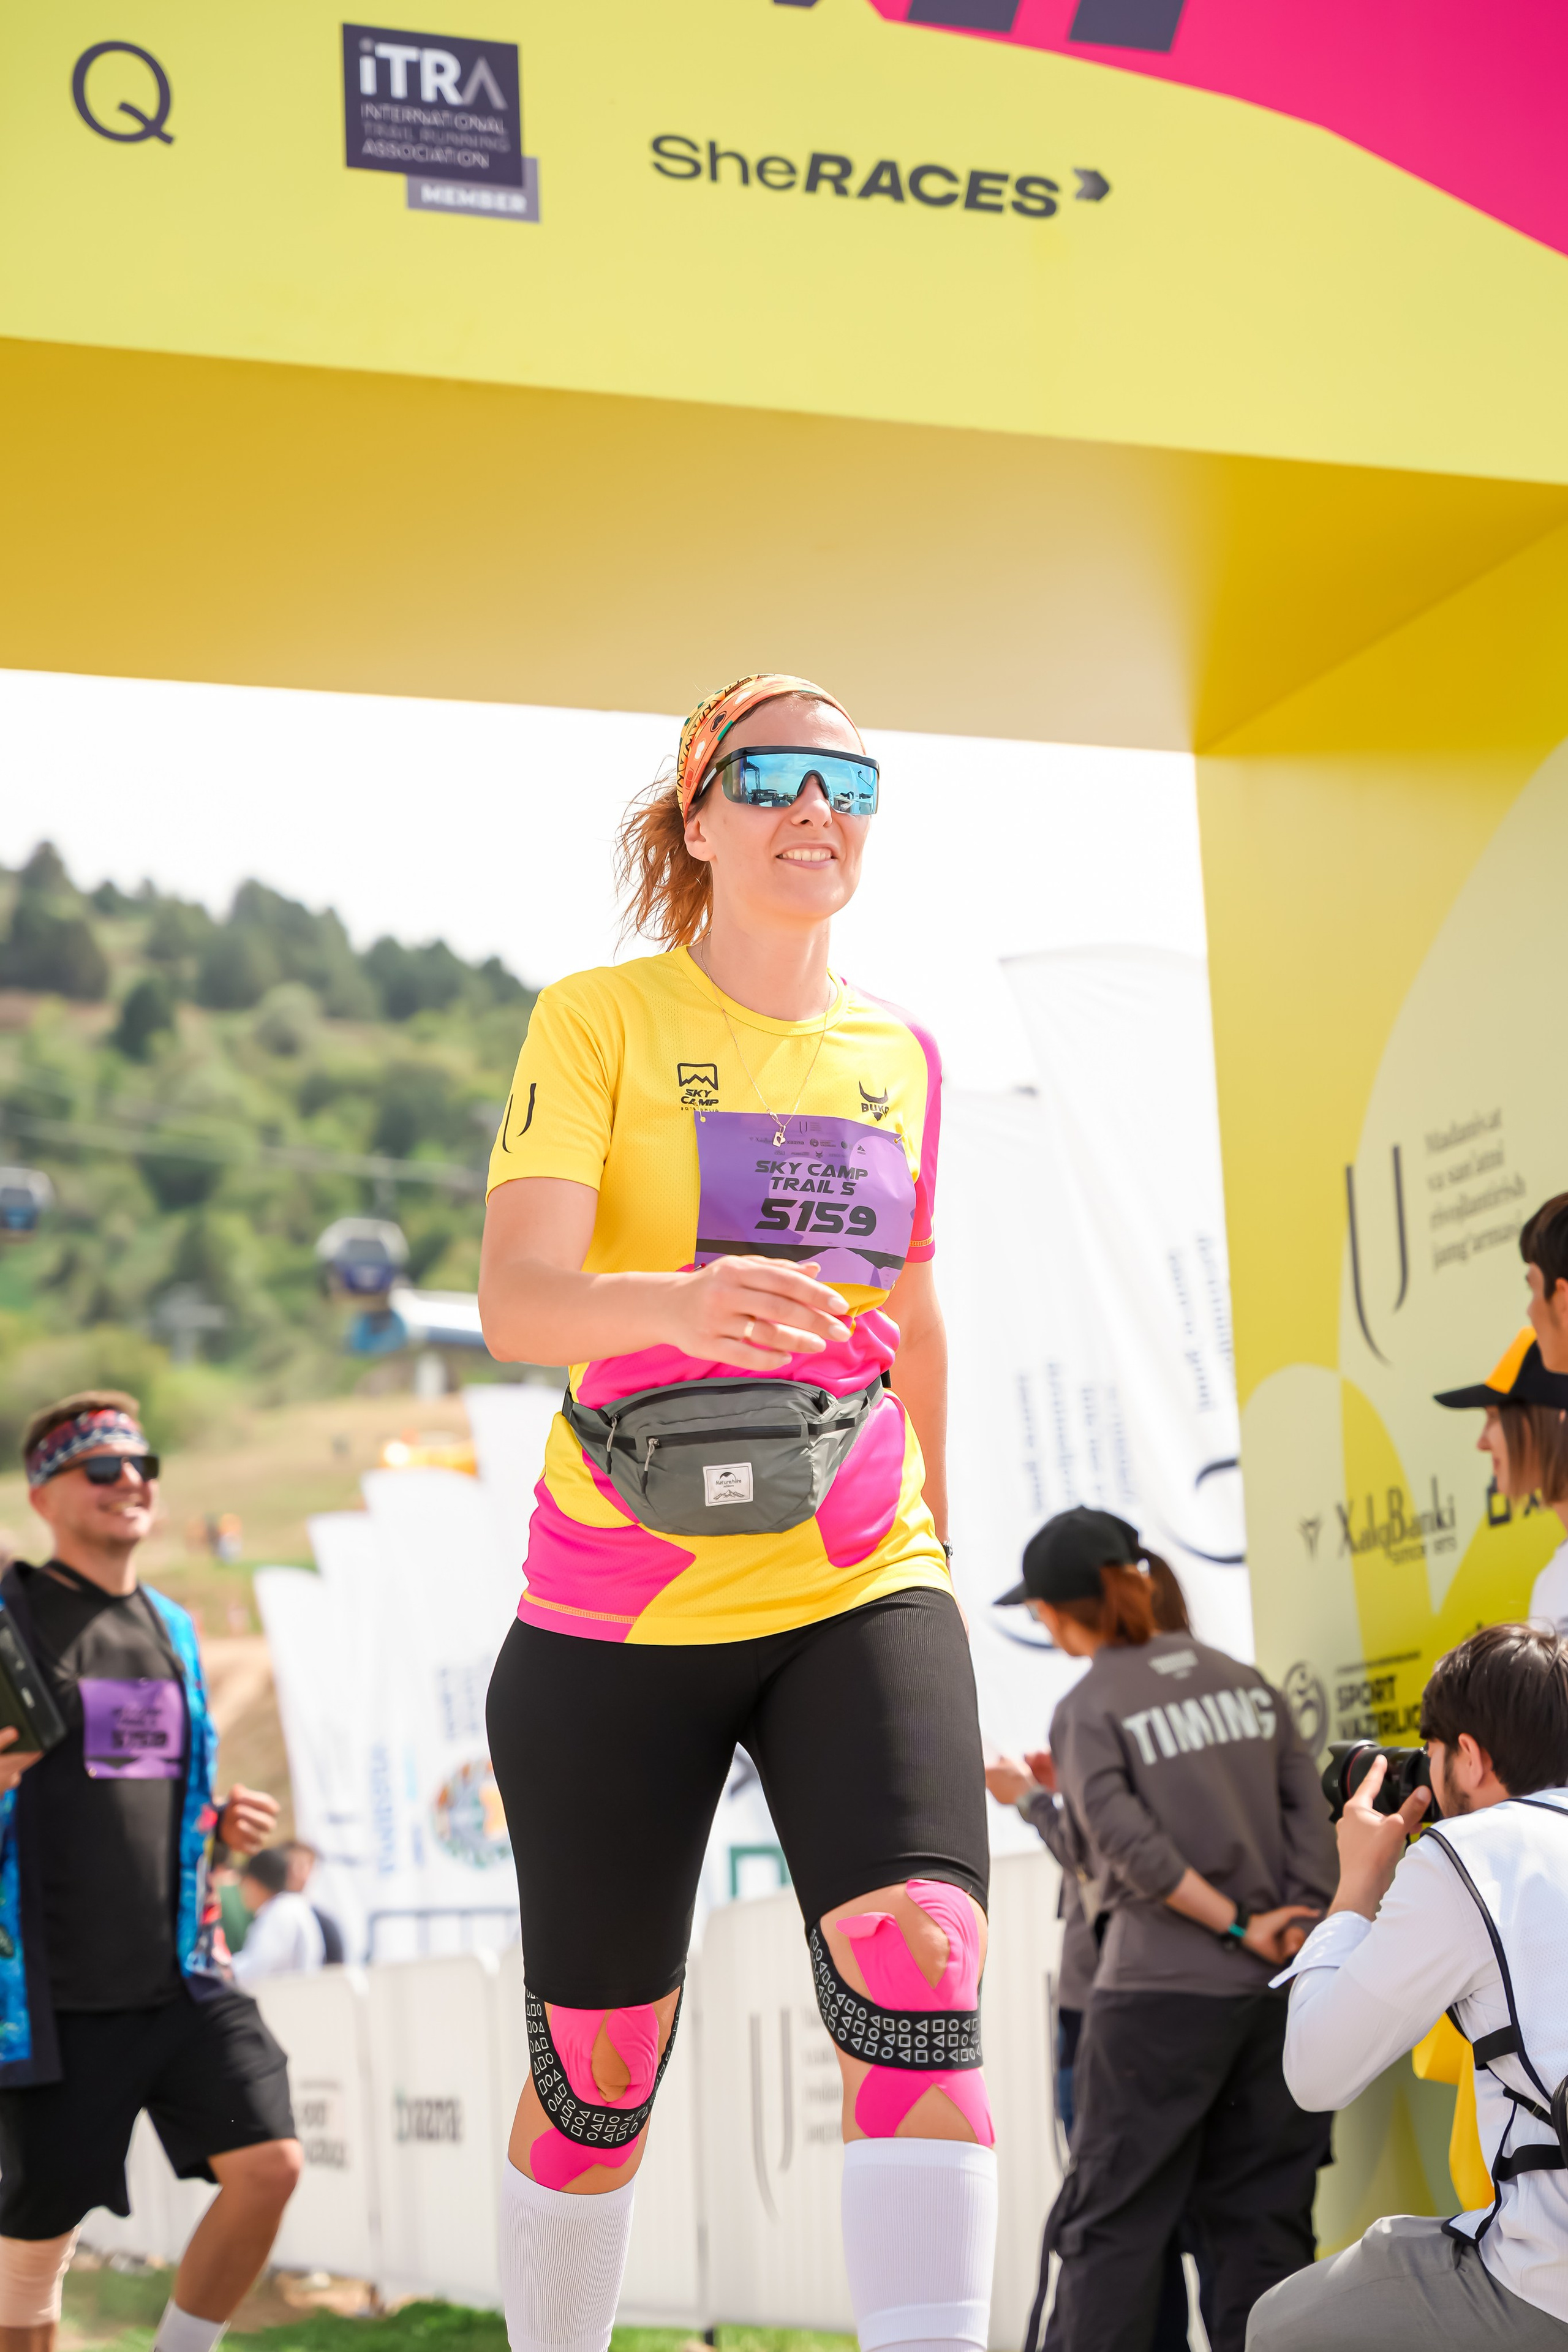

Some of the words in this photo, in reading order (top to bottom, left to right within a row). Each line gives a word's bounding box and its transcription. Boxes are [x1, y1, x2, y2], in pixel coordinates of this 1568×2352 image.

[361, 102, 504, 134] INTERNATIONAL
[364, 122, 413, 141] TRAIL
[419, 126, 511, 153] RUNNING
[361, 138, 489, 169] ASSOCIATION
[650, 134, 1060, 219] SheRACES
[421, 184, 527, 213] MEMBER
[680, 1096, 719, 1106] CAMP
[685, 1088, 712, 1098] SKY
[755, 1160, 802, 1175] SKY
[807, 1164, 869, 1180] CAMP
[771, 1177, 835, 1194] TRAIL
[754, 1197, 876, 1237] 5159
[1121, 1687, 1276, 1766] TIMING
